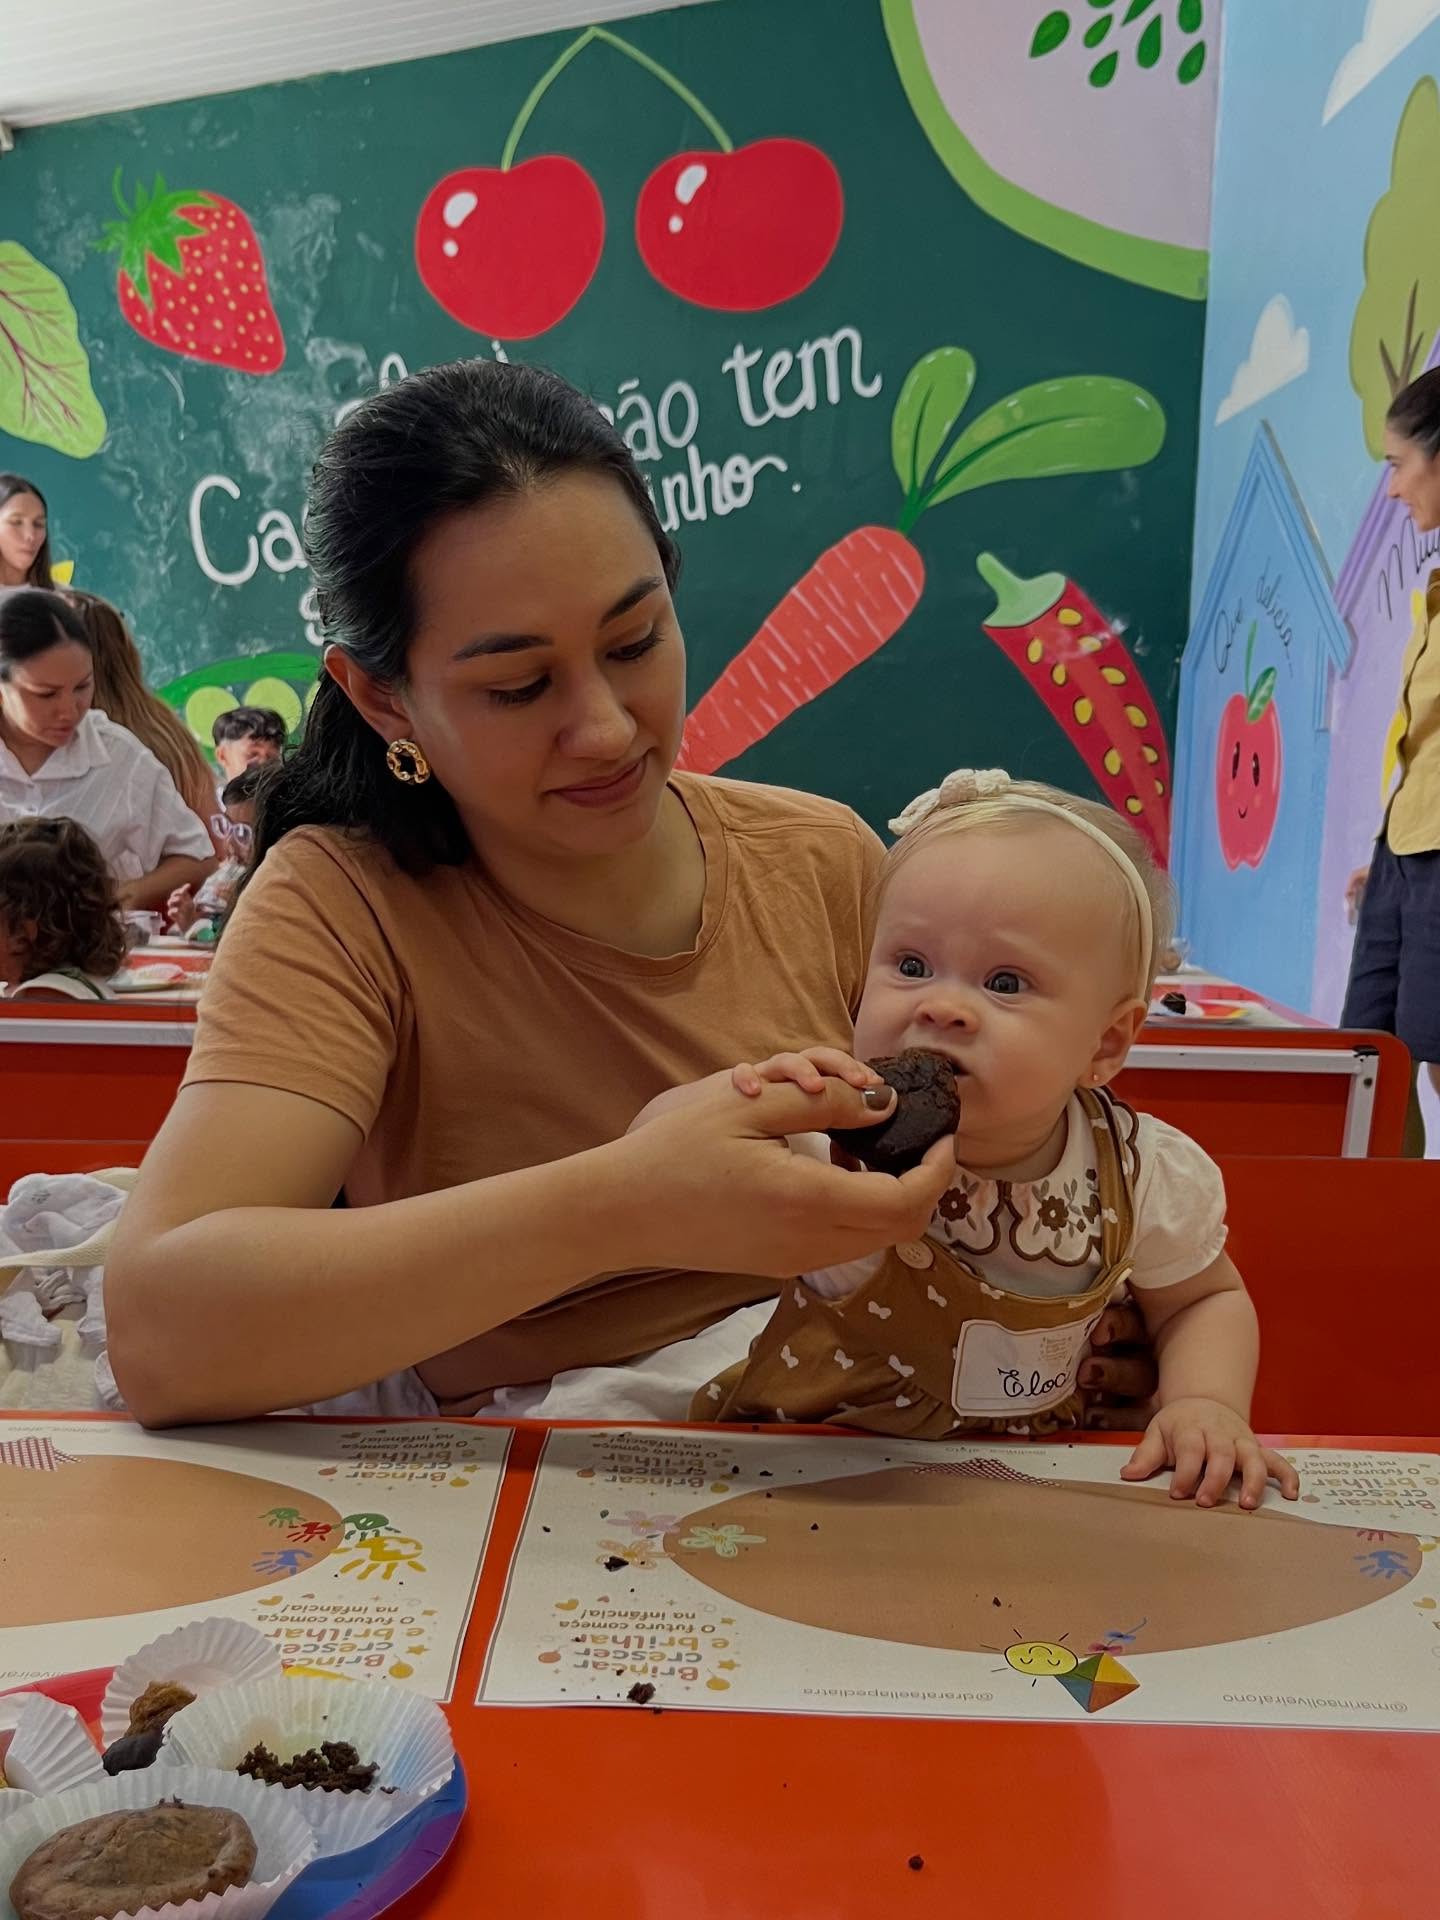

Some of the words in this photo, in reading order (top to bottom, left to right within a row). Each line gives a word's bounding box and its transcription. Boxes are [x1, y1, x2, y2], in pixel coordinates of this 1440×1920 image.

[721, 325, 883, 429] tem
[346, 1450, 452, 1462] brilhar
[461, 1450, 477, 1459] e
[348, 1461, 452, 1472] crescer
[601, 1454, 704, 1469] brilhar
[346, 1470, 447, 1482] Brincar
[605, 1466, 708, 1478] crescer
[605, 1475, 704, 1488] Brincar
[1311, 1478, 1417, 1488] brilhar
[1423, 1477, 1440, 1487] e
[1324, 1489, 1427, 1500] crescer
[1333, 1499, 1436, 1510] Brincar
[281, 1604, 368, 1615] infância!
[375, 1606, 399, 1614] na
[580, 1608, 666, 1620] infância!
[256, 1613, 328, 1624] começa
[334, 1616, 393, 1625] futuro
[400, 1616, 415, 1625] O
[672, 1612, 696, 1620] na
[558, 1619, 629, 1630] começa
[634, 1622, 694, 1632] futuro
[701, 1624, 716, 1634] O
[263, 1627, 396, 1642] brilhar
[405, 1628, 425, 1638] e
[571, 1634, 699, 1650] brilhar
[711, 1638, 730, 1650] e
[280, 1653, 385, 1669] Brinca
[573, 1648, 703, 1665] crescer
[572, 1660, 699, 1681] Brincar
[1221, 1693, 1408, 1715] @marinaoliveirafono
